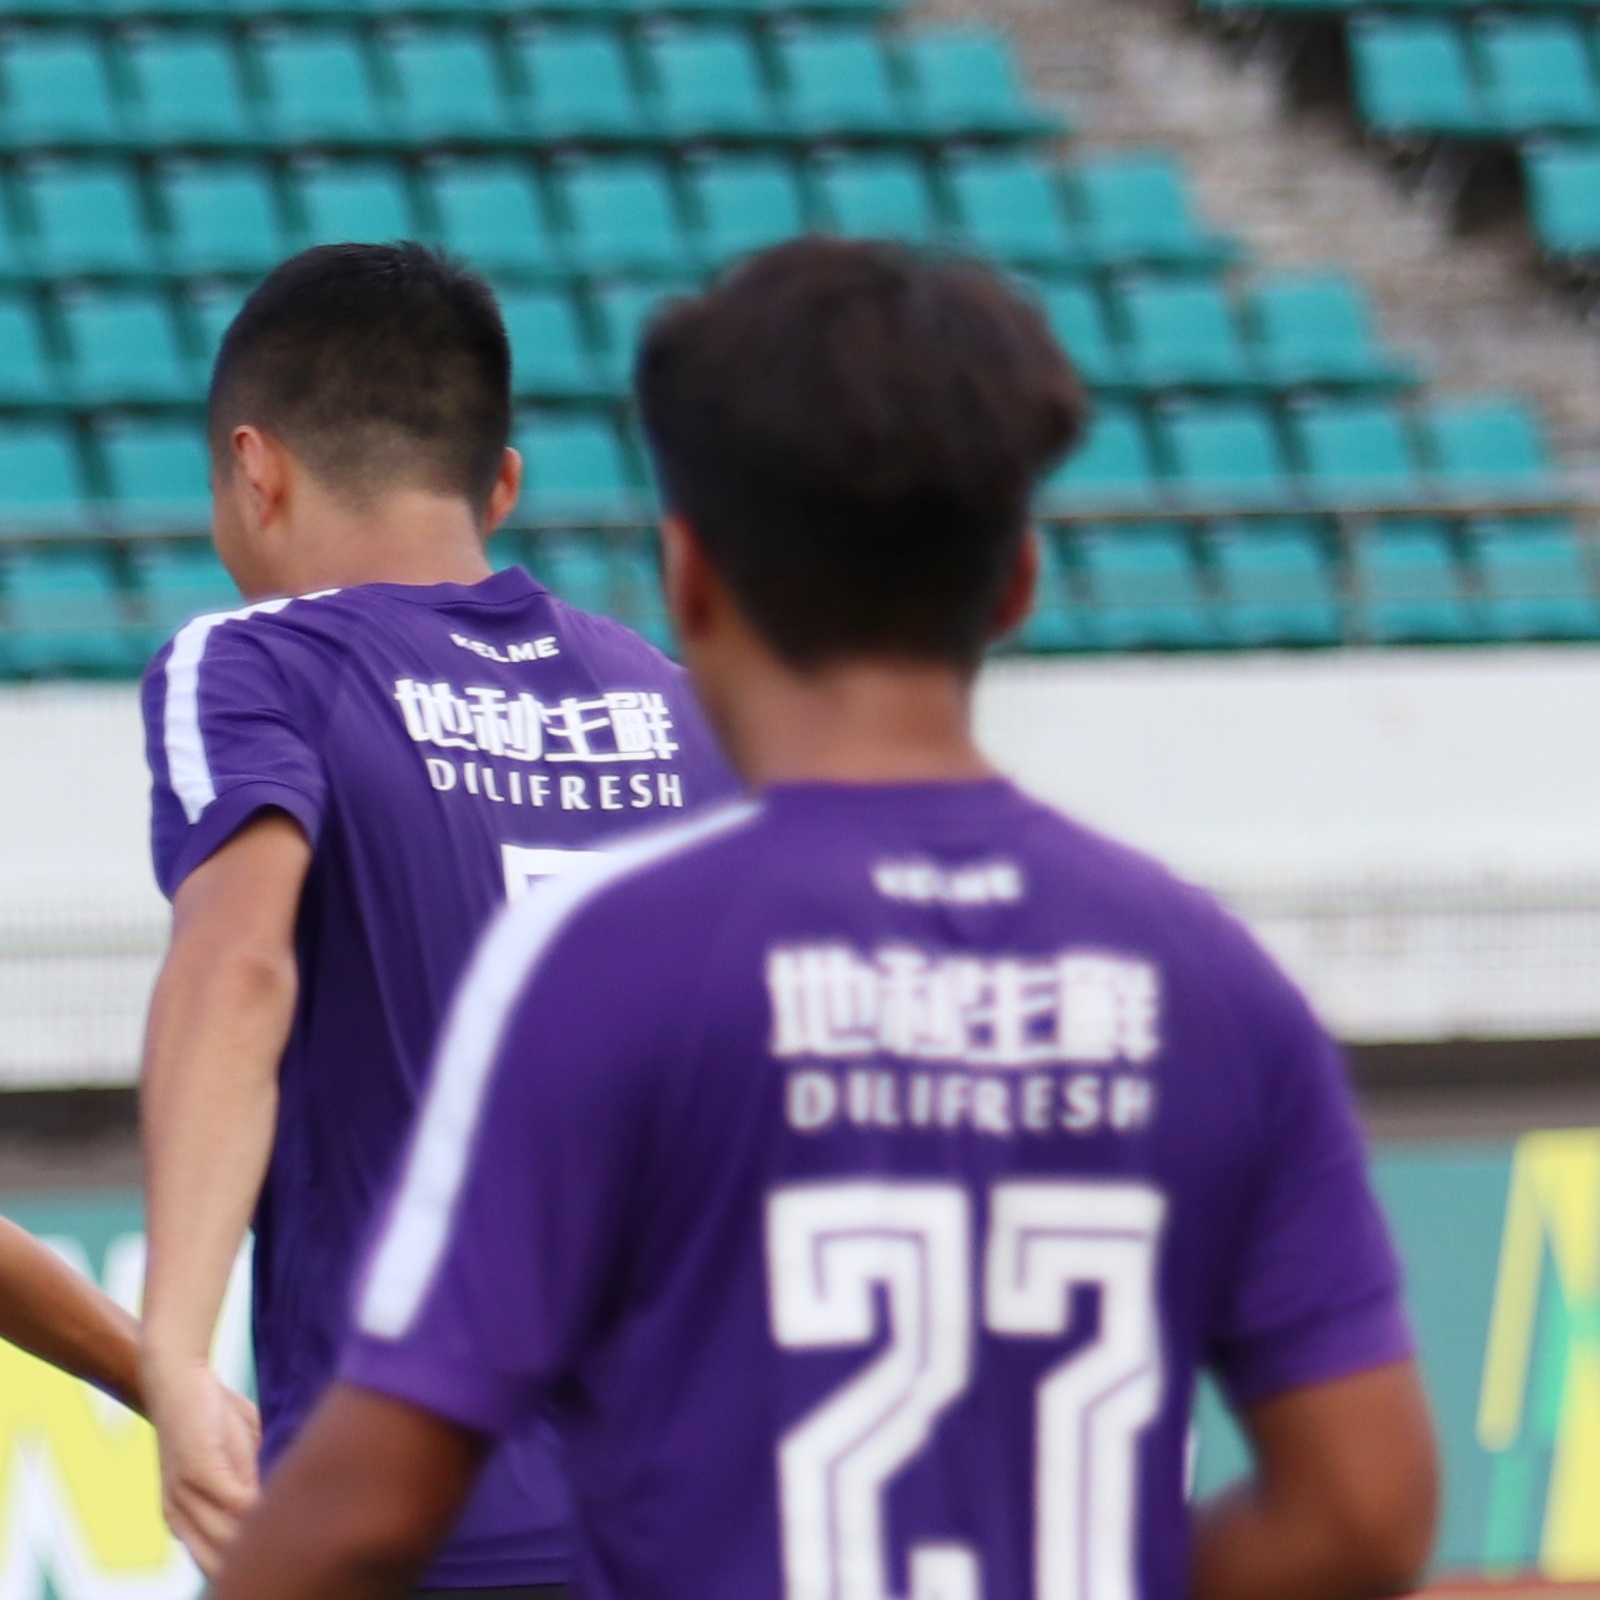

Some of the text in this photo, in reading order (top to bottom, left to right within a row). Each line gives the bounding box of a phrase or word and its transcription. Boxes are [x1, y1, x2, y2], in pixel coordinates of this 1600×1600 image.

[449, 632, 560, 663] KELME
[394, 677, 679, 762] 地利生鲜
[427, 758, 684, 811] DILIFRESH
[766, 943, 1161, 1066] 地利生鲜
[786, 1071, 1155, 1130] DILIFRESH
